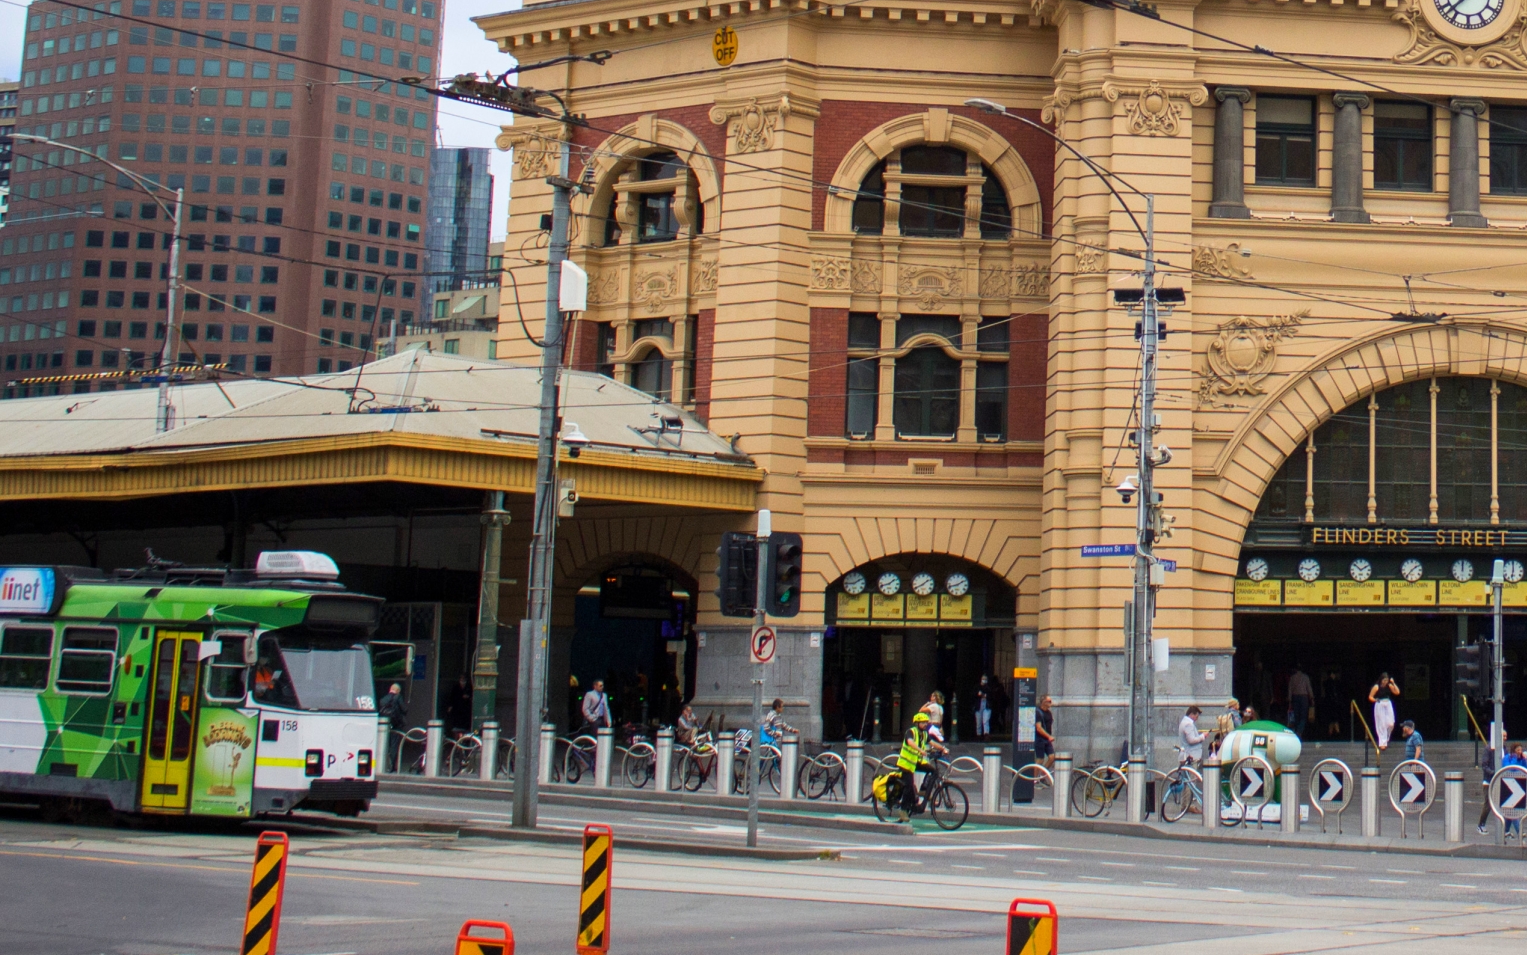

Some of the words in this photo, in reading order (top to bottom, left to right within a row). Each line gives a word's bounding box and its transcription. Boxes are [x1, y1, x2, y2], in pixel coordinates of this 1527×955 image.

[714, 31, 734, 46] CUT
[716, 47, 735, 61] OFF
[1313, 527, 1410, 545] FLINDERS
[1436, 529, 1509, 546] STREET
[1083, 546, 1113, 554] Swanston
[1114, 545, 1121, 553] St
[2, 577, 41, 601] iinet
[356, 696, 375, 710] 158
[281, 720, 298, 731] 158
